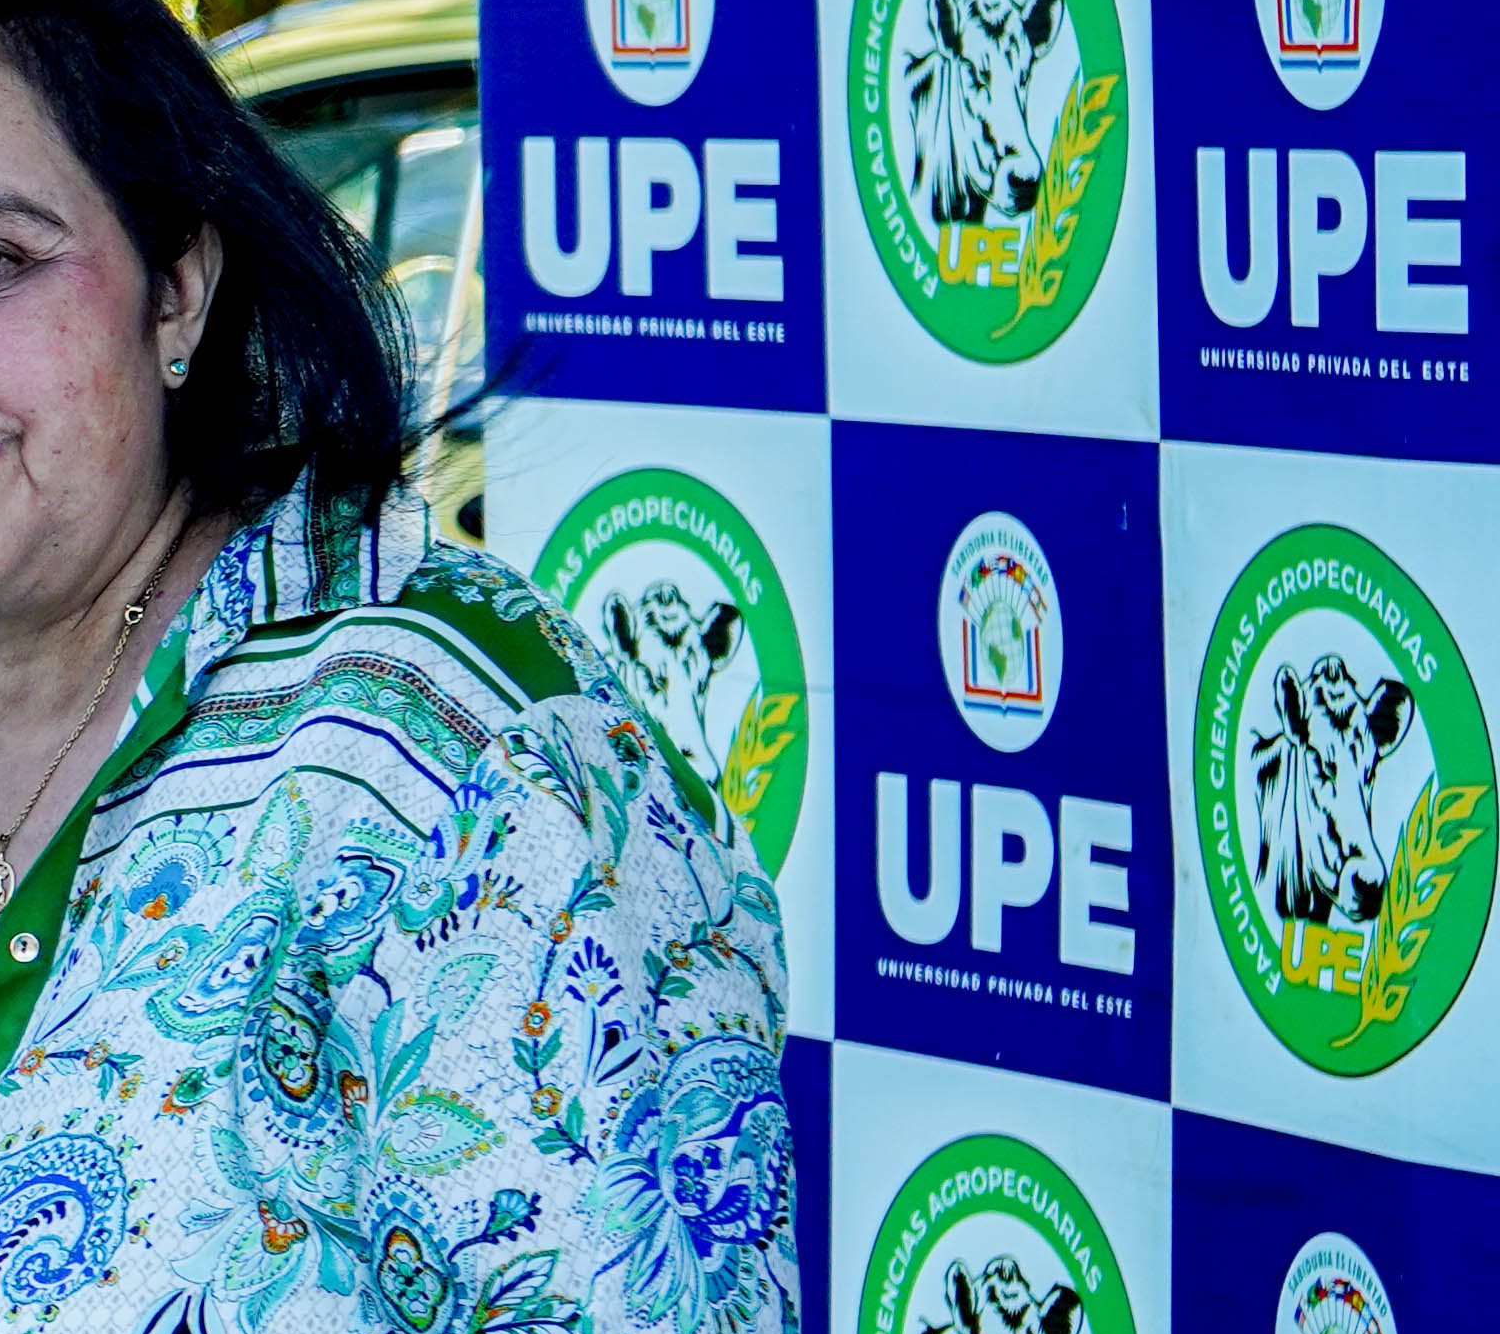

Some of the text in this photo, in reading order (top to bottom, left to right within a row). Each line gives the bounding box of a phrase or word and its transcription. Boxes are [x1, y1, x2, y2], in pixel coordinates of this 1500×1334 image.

[522, 136, 785, 302] UPE
[864, 130, 940, 300] FACULTAD
[937, 224, 1023, 288] UPE
[1197, 147, 1469, 334] UPE
[525, 312, 785, 344] UNIVERSIDAD PRIVADA DEL ESTE
[1200, 347, 1469, 382] UNIVERSIDAD PRIVADA DEL ESTE
[581, 494, 762, 607] AGROPECUARIAS
[1209, 558, 1439, 997] FACULTAD CIENCIAS AGROPECUARIAS
[876, 771, 1135, 976] UPE
[877, 957, 1132, 1019] UNIVERSIDAD PRIVADA DEL ESTE
[1279, 920, 1364, 996] UPE
[926, 1166, 1103, 1294] AGROPECUARIAS
